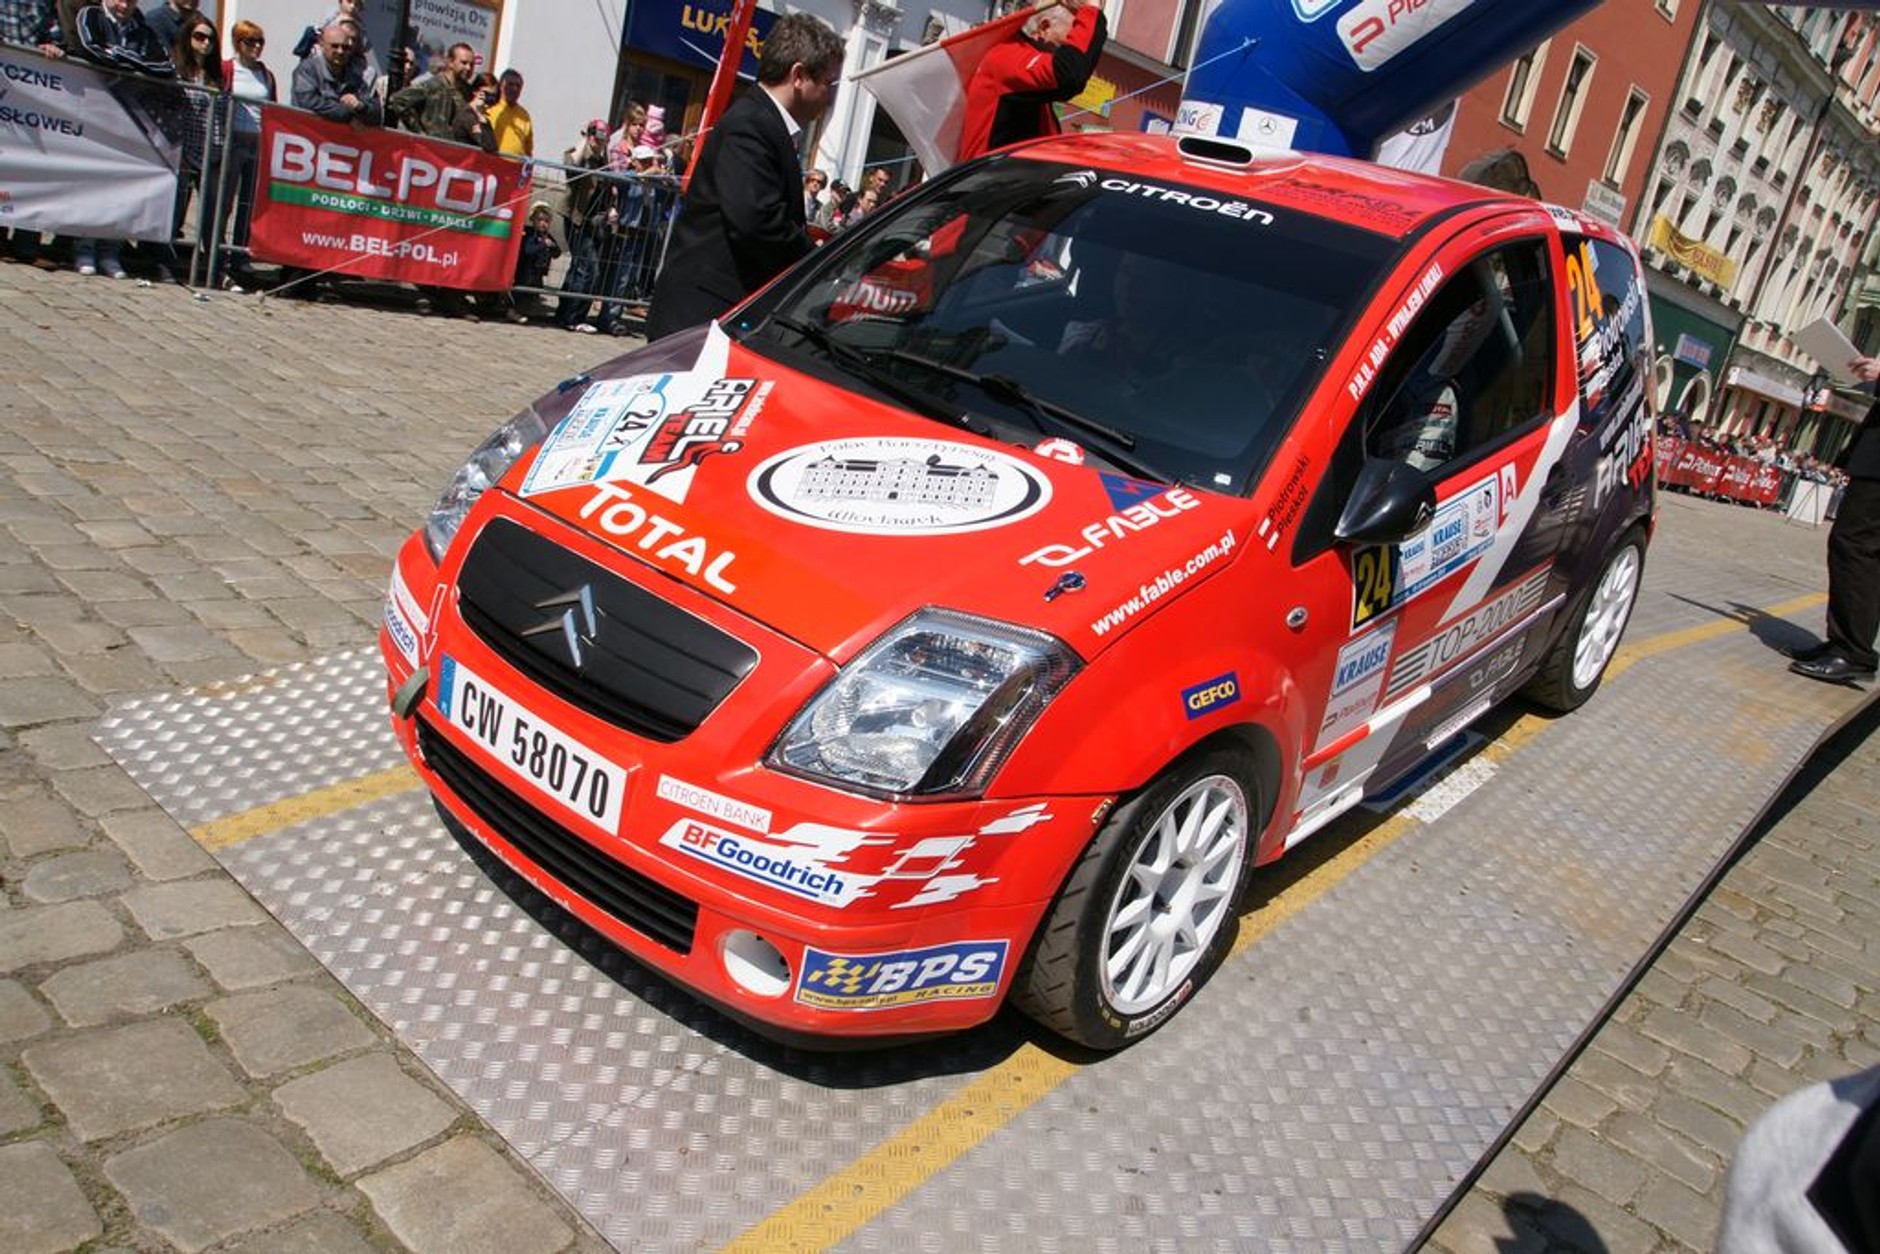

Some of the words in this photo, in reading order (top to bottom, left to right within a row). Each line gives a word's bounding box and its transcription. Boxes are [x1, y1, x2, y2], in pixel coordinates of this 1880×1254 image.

[0, 63, 63, 91] CZNE
[269, 131, 514, 221] BEL-POL
[302, 231, 458, 267] www.BEL-POL.pl
[1566, 240, 1604, 343] 24
[667, 377, 758, 463] ARIEL
[579, 482, 737, 596] TOTAL
[1082, 489, 1201, 548] FABLE
[1091, 529, 1237, 637] www.fable.com.pl
[1356, 544, 1392, 623] 24
[1336, 641, 1388, 689] KRAUSE
[1429, 589, 1524, 669] TOP-2000
[1188, 680, 1235, 710] GEFCO
[460, 680, 504, 748] CW
[511, 717, 609, 819] 58070
[723, 802, 768, 830] BANK
[682, 823, 845, 895] BFGoodrich
[866, 951, 998, 994] BPS
[914, 985, 992, 999] RACING
